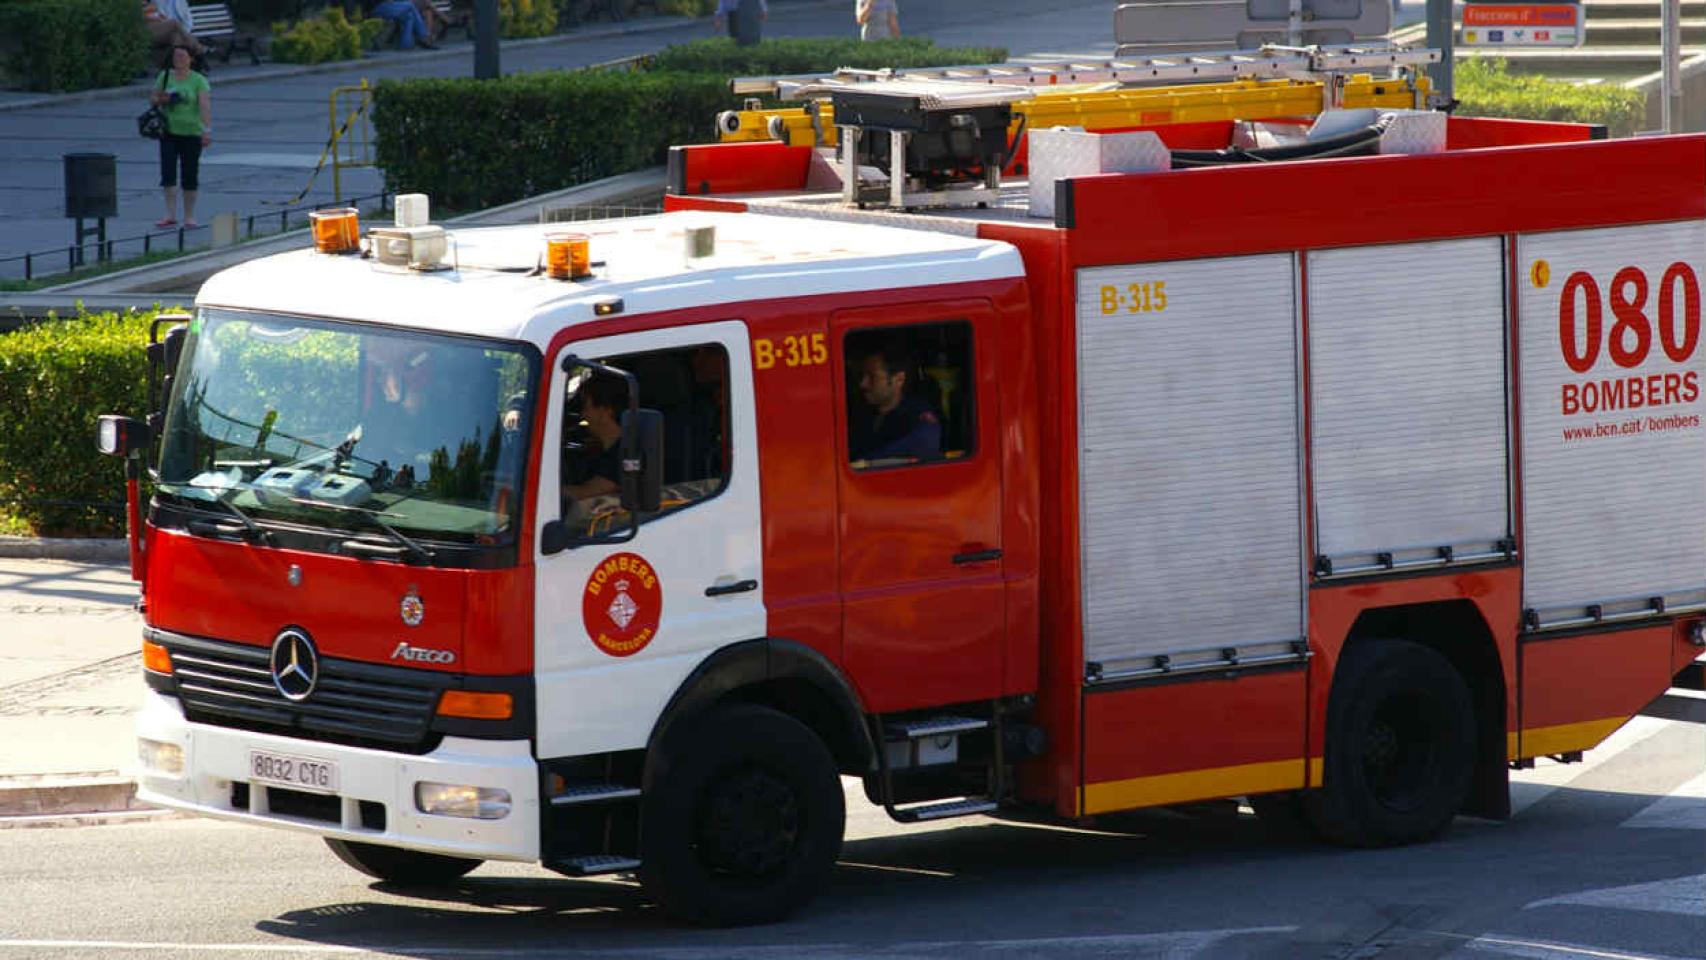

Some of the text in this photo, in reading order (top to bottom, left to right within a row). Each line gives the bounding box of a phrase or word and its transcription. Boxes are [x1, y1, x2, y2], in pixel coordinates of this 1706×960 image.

[1559, 260, 1702, 374] 080
[1561, 370, 1700, 416] BOMBERS
[1563, 414, 1700, 442] www.bcn.cat/bombers
[588, 556, 656, 596] BOMBERS
[598, 627, 652, 651] BARCELONA
[299, 762, 329, 786] CTG
